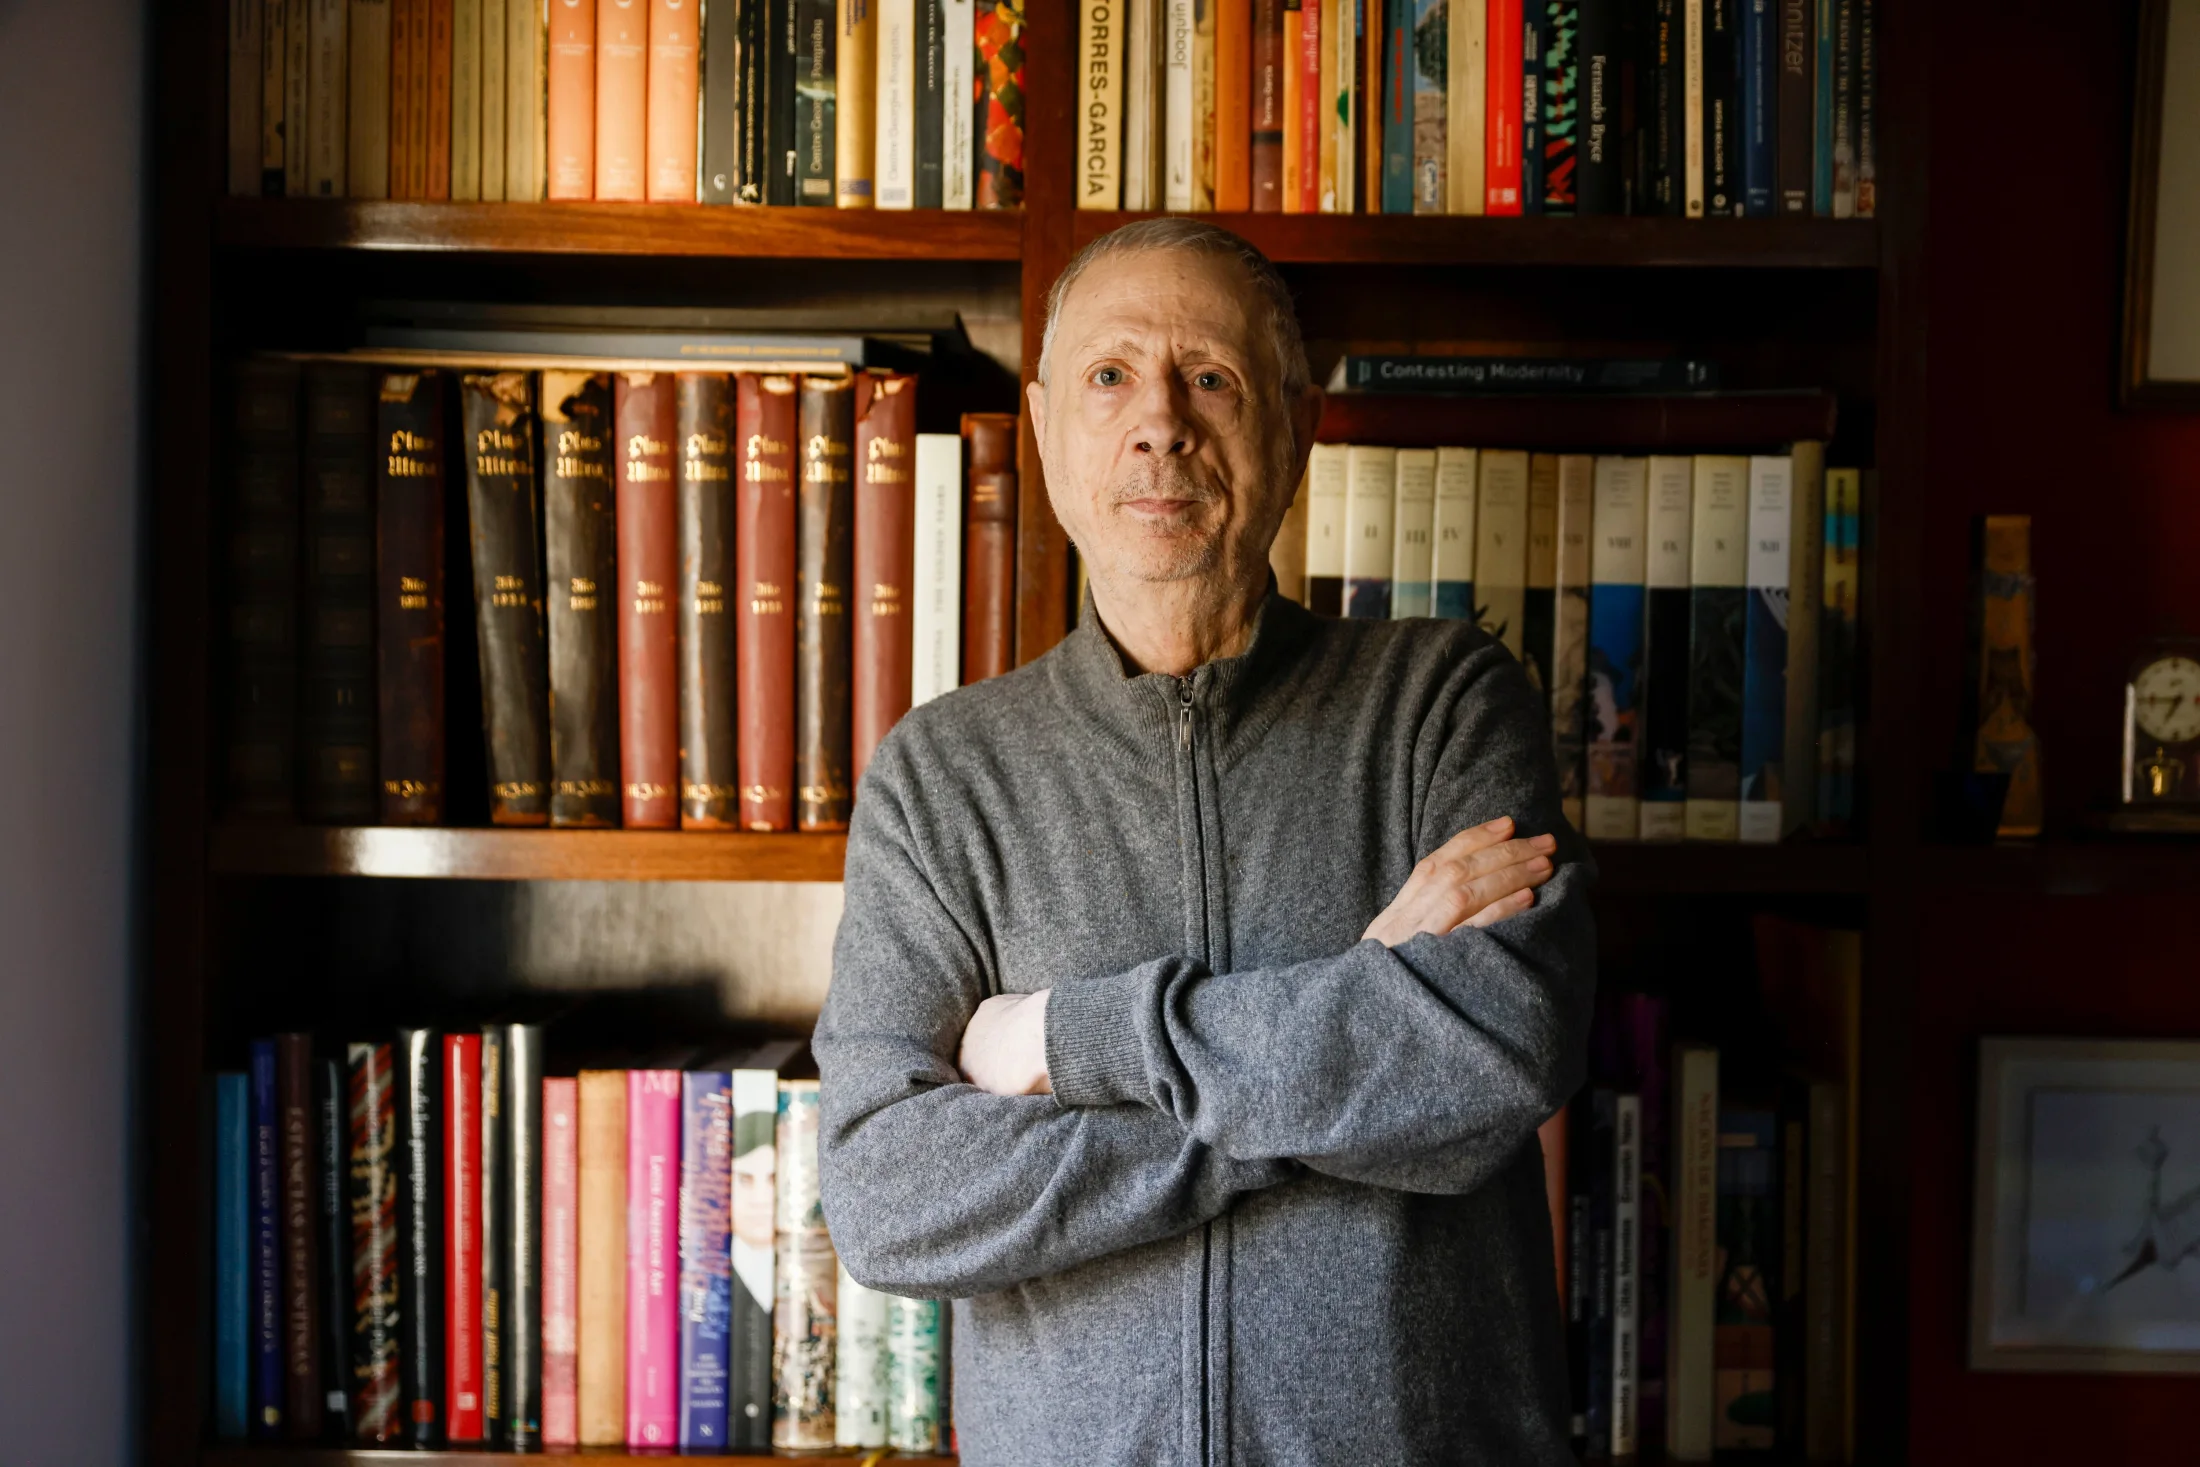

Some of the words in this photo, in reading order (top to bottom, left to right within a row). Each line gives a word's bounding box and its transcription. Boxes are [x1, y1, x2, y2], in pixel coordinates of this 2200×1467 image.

[811, 19, 825, 79] Pompidou
[1169, 2, 1191, 70] Joaquín
[811, 82, 823, 132] Geors
[1590, 54, 1607, 122] Fernando
[811, 133, 823, 173] Centre
[1587, 124, 1606, 164] Bryce
[1380, 361, 1484, 383] Contesting
[1491, 362, 1585, 383] Modernity
[559, 431, 601, 455] Plus
[1324, 523, 1330, 538] I
[1364, 524, 1377, 539] II
[1405, 529, 1426, 544] III
[650, 1155, 665, 1195] Latin
[650, 1197, 664, 1268] American
